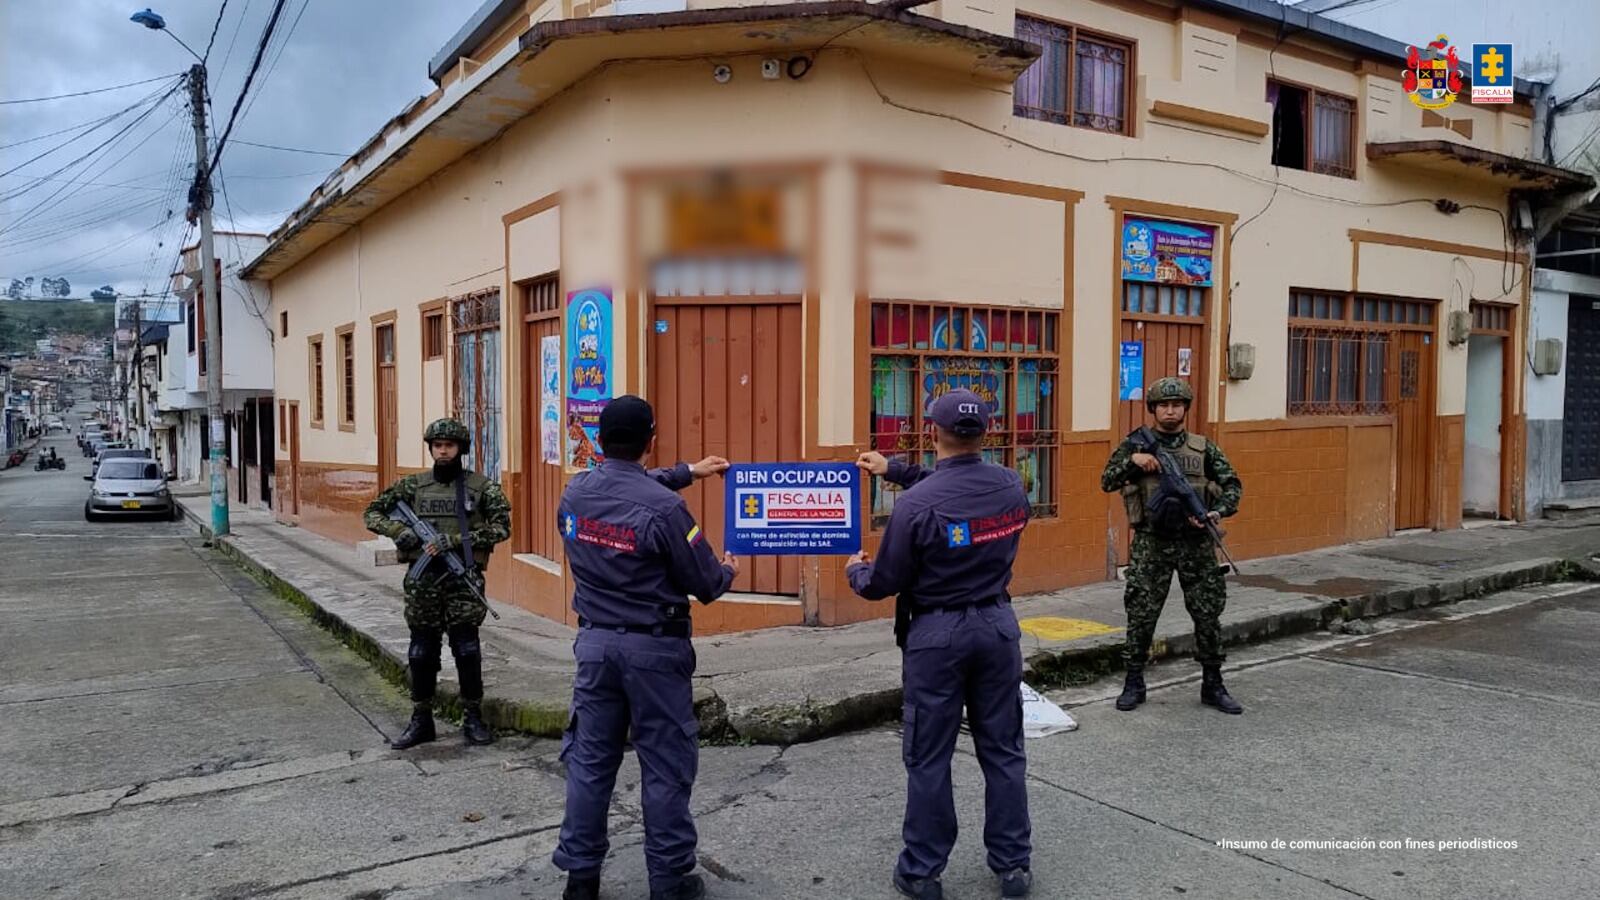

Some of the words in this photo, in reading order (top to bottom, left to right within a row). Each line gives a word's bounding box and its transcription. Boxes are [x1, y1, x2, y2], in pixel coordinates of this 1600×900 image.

[959, 403, 979, 414] CTI
[736, 470, 768, 484] BIEN
[772, 470, 851, 484] OCUPADO
[768, 491, 844, 505] FISCALÍA
[751, 531, 767, 539] fines
[768, 531, 778, 539] de
[811, 531, 821, 539] de
[822, 531, 850, 539] dominio
